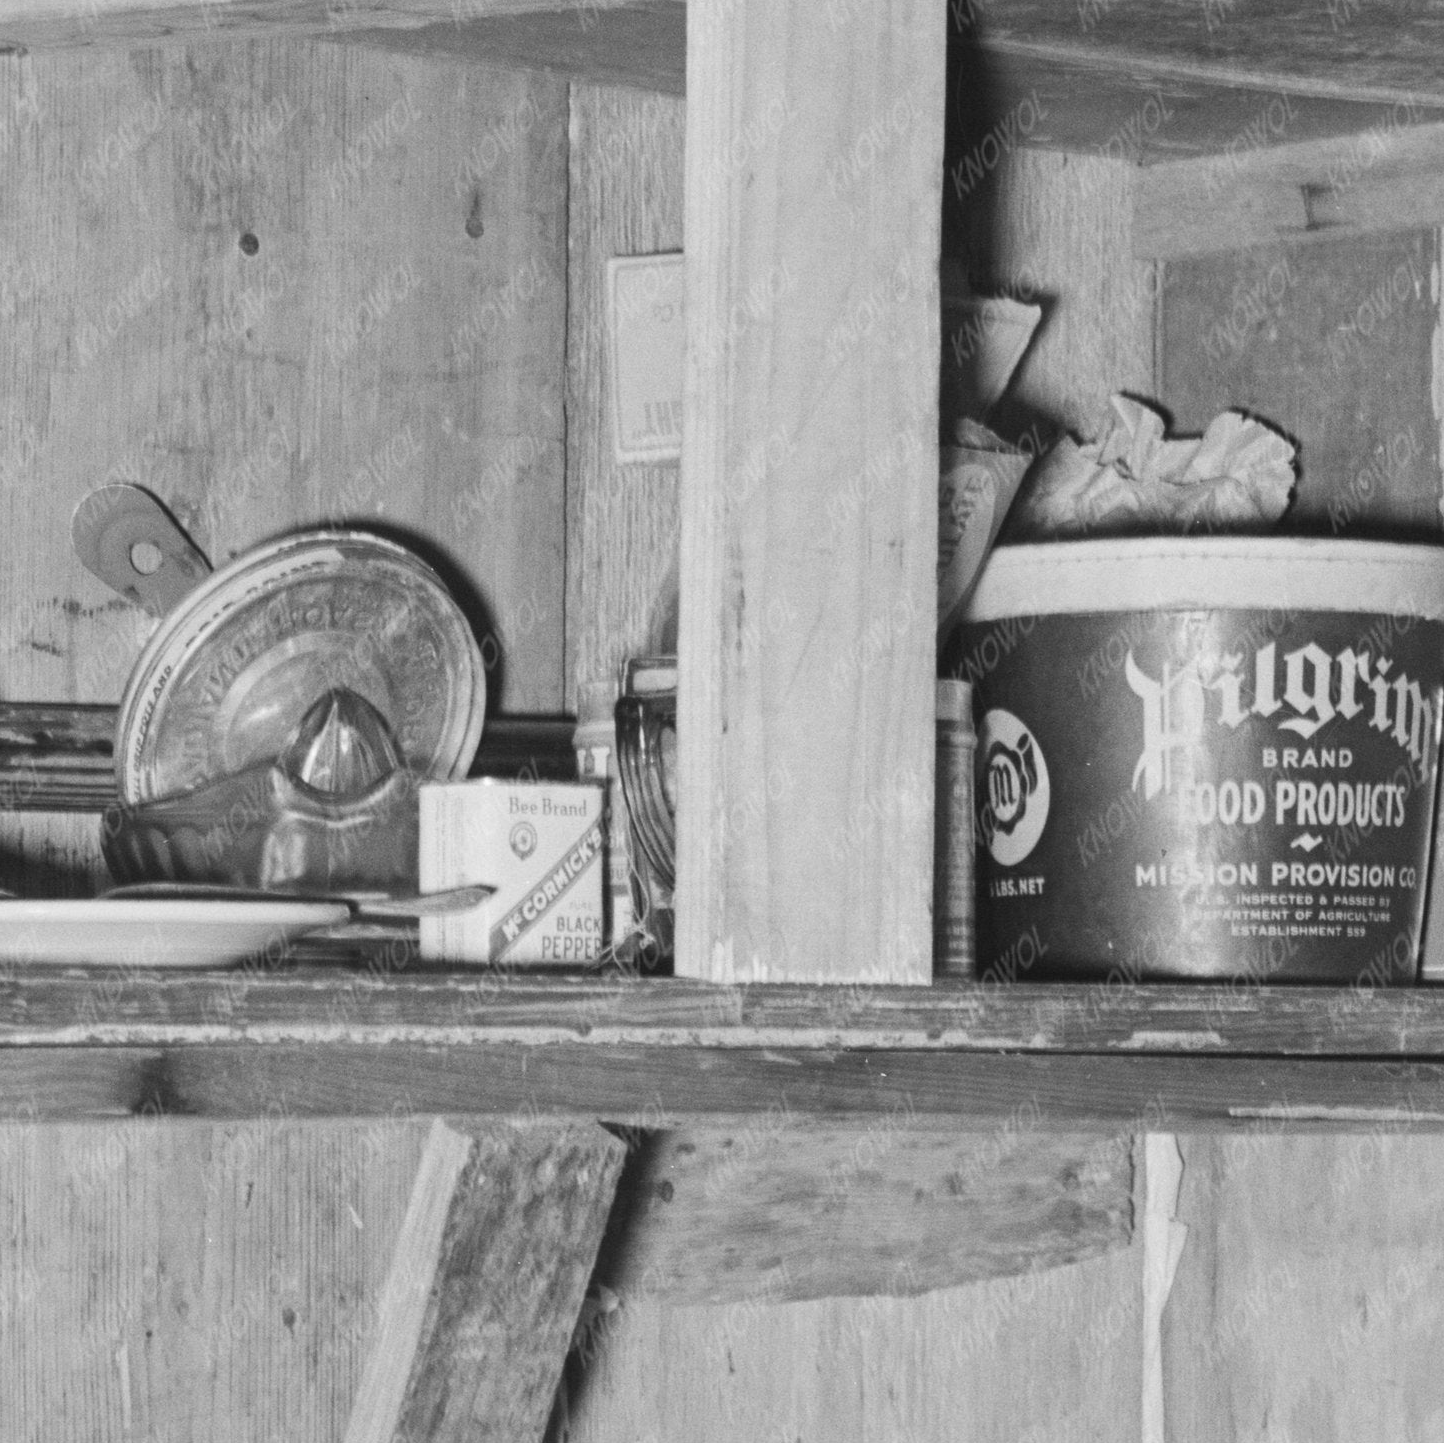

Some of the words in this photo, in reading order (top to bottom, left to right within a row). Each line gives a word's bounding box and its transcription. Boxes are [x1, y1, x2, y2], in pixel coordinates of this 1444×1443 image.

[1125, 641, 1434, 801] Pilgrim
[1261, 747, 1354, 769] BRAND
[508, 797, 538, 816] Bee
[542, 798, 588, 817] Brand
[1178, 779, 1266, 826] FOOD
[1275, 780, 1407, 827] PRODUCTS
[500, 825, 602, 943] McCORMICK'S
[1134, 862, 1259, 888] MISSION
[1271, 862, 1395, 888] PROVISION
[1235, 893, 1314, 906] INSPECTED
[1332, 895, 1376, 907] PASSED
[556, 916, 602, 933] BLACK
[1192, 909, 1289, 922] DEPARTMENT
[1294, 910, 1313, 922] OF
[1318, 910, 1392, 923] AGRICULTURE
[1230, 924, 1343, 938] ESTABLISHMENT
[541, 935, 602, 960] PEPPER
